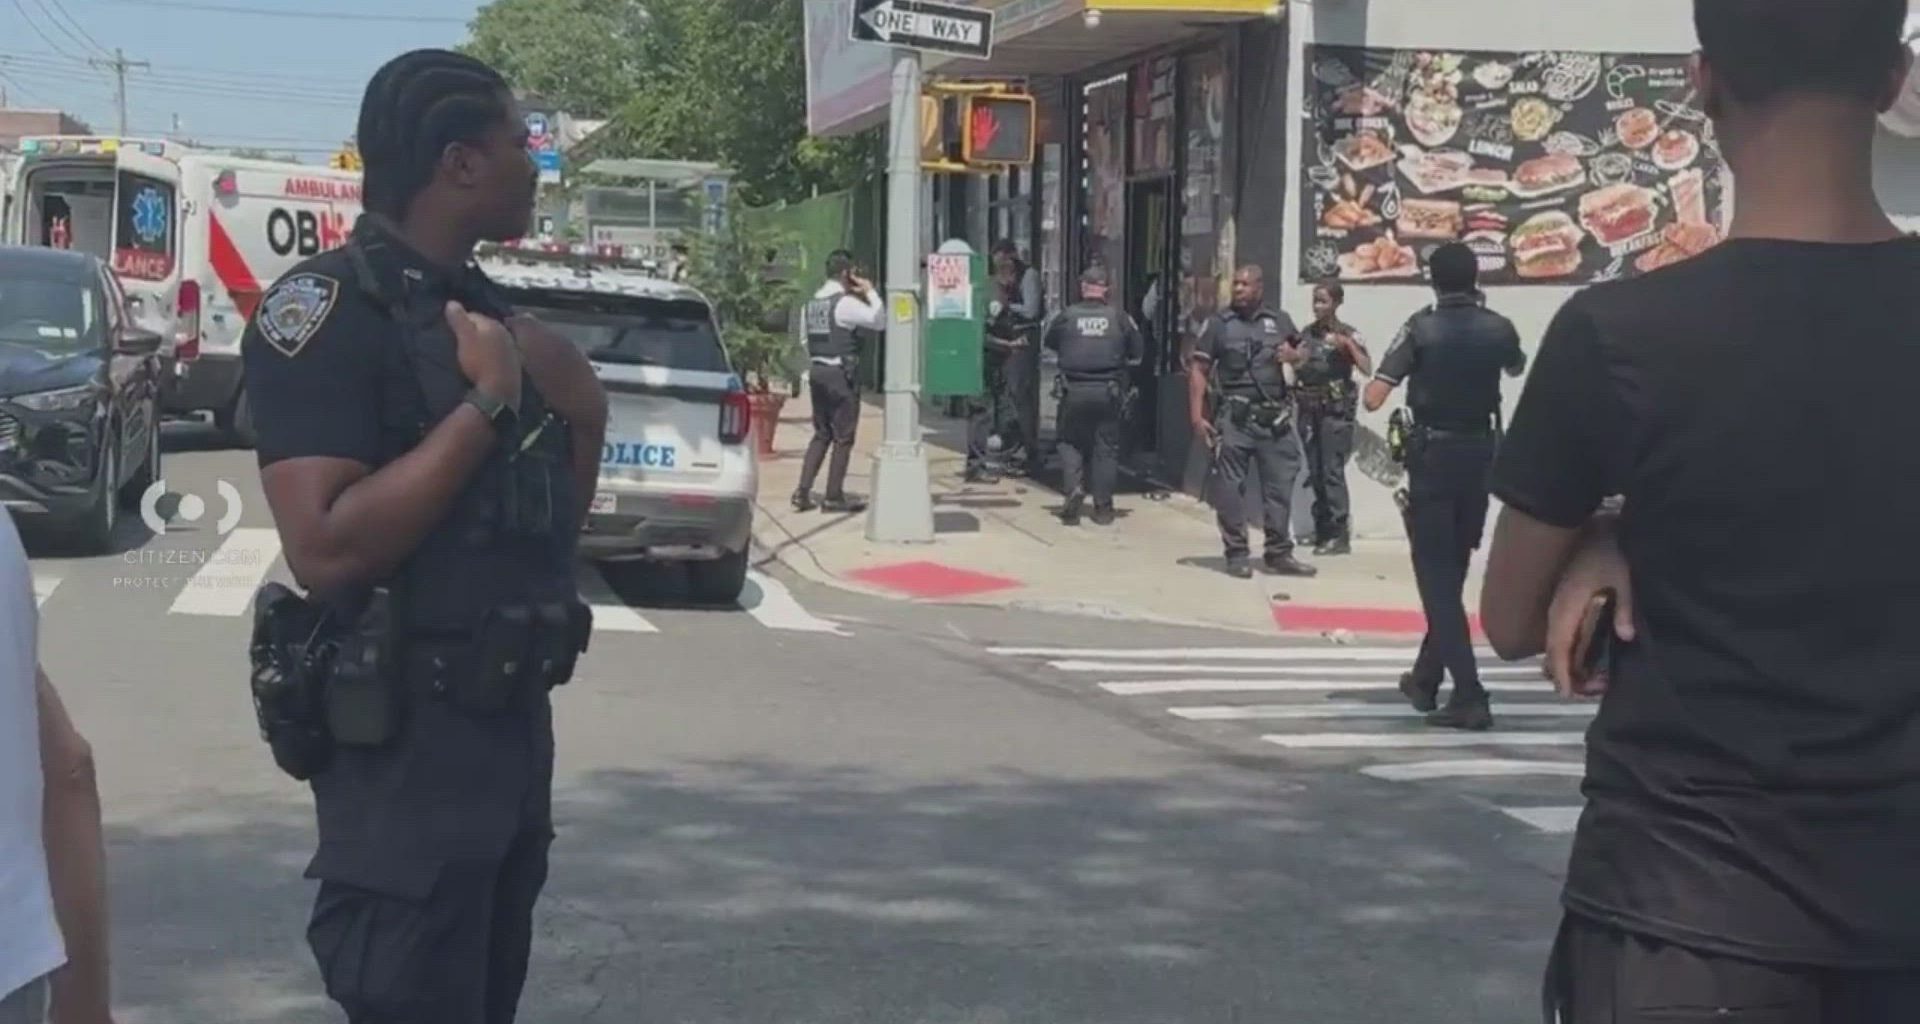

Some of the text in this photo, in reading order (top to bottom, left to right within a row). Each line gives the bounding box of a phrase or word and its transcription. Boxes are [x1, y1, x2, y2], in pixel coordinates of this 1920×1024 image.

[873, 9, 974, 41] ONE WAY
[1077, 317, 1109, 330] NYPD
